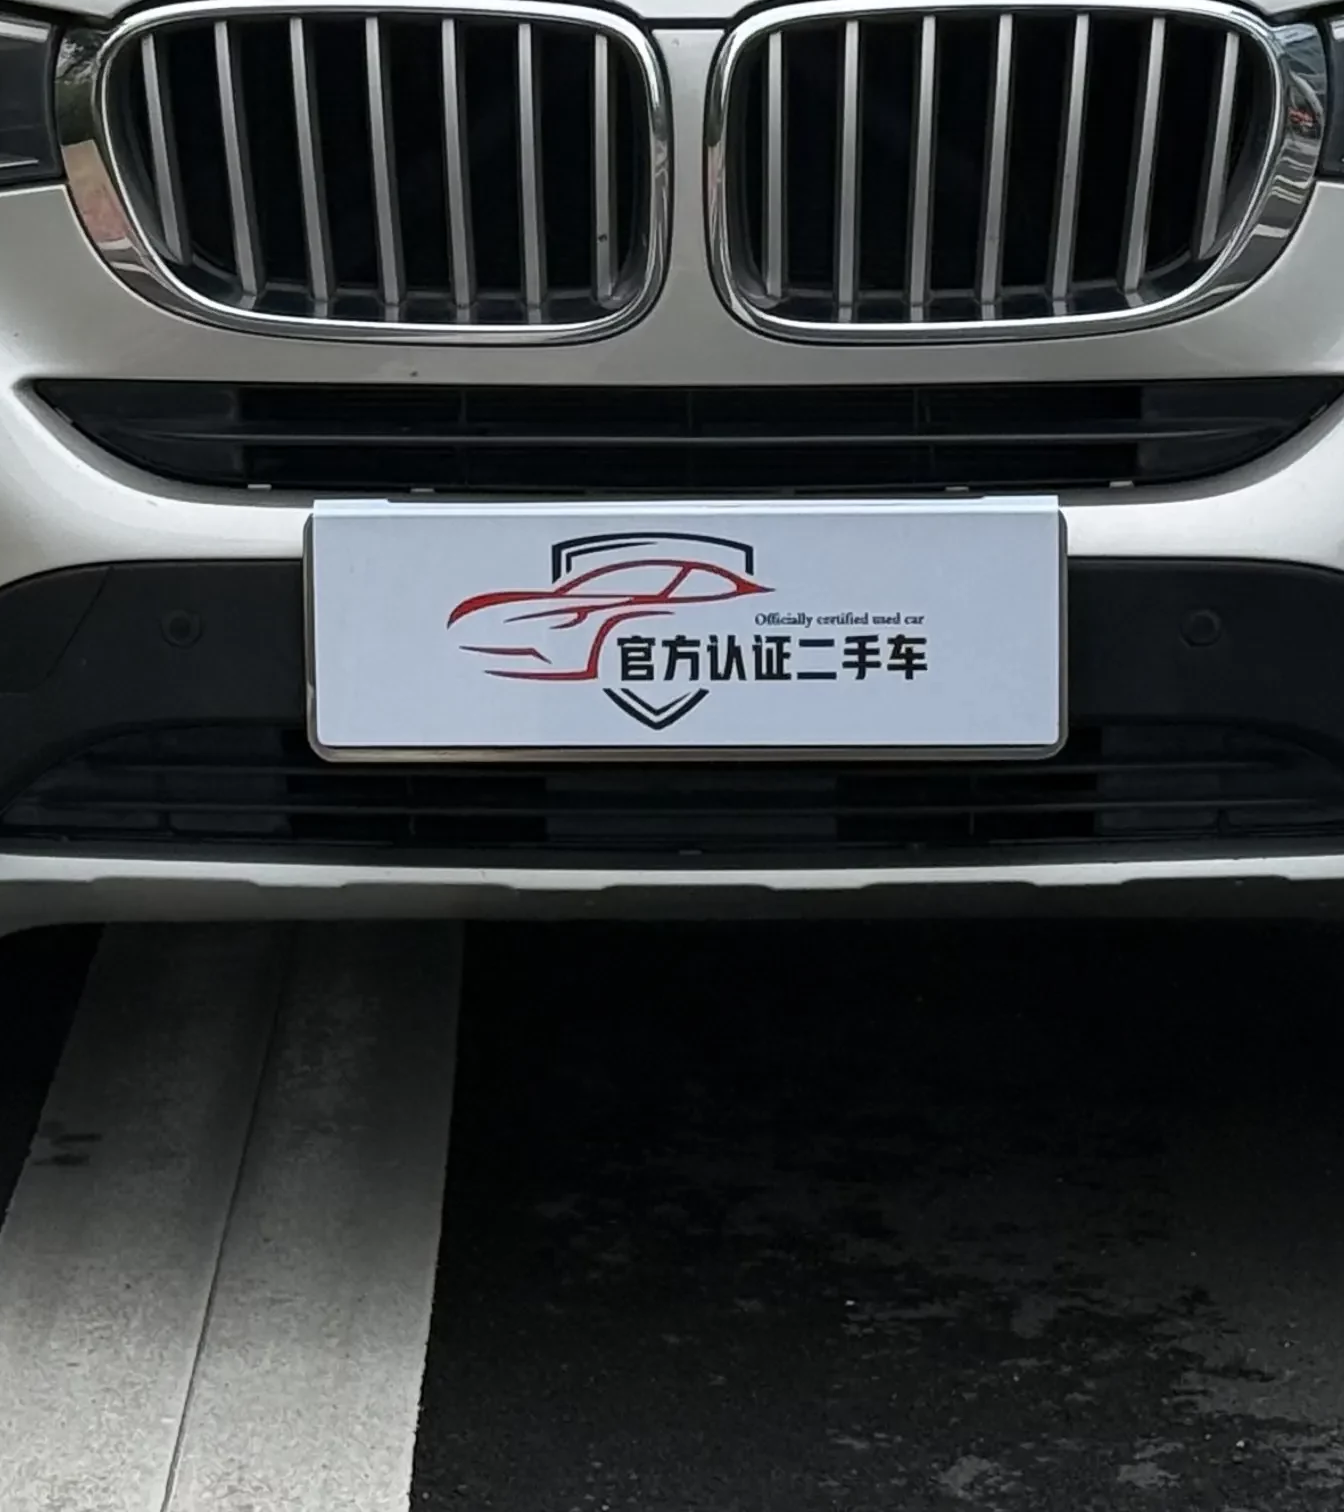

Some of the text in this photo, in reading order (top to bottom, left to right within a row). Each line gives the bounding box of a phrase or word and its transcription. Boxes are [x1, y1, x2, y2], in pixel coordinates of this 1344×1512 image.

[754, 612, 925, 628] Officially certified used car
[617, 634, 928, 681] 官方认证二手车
